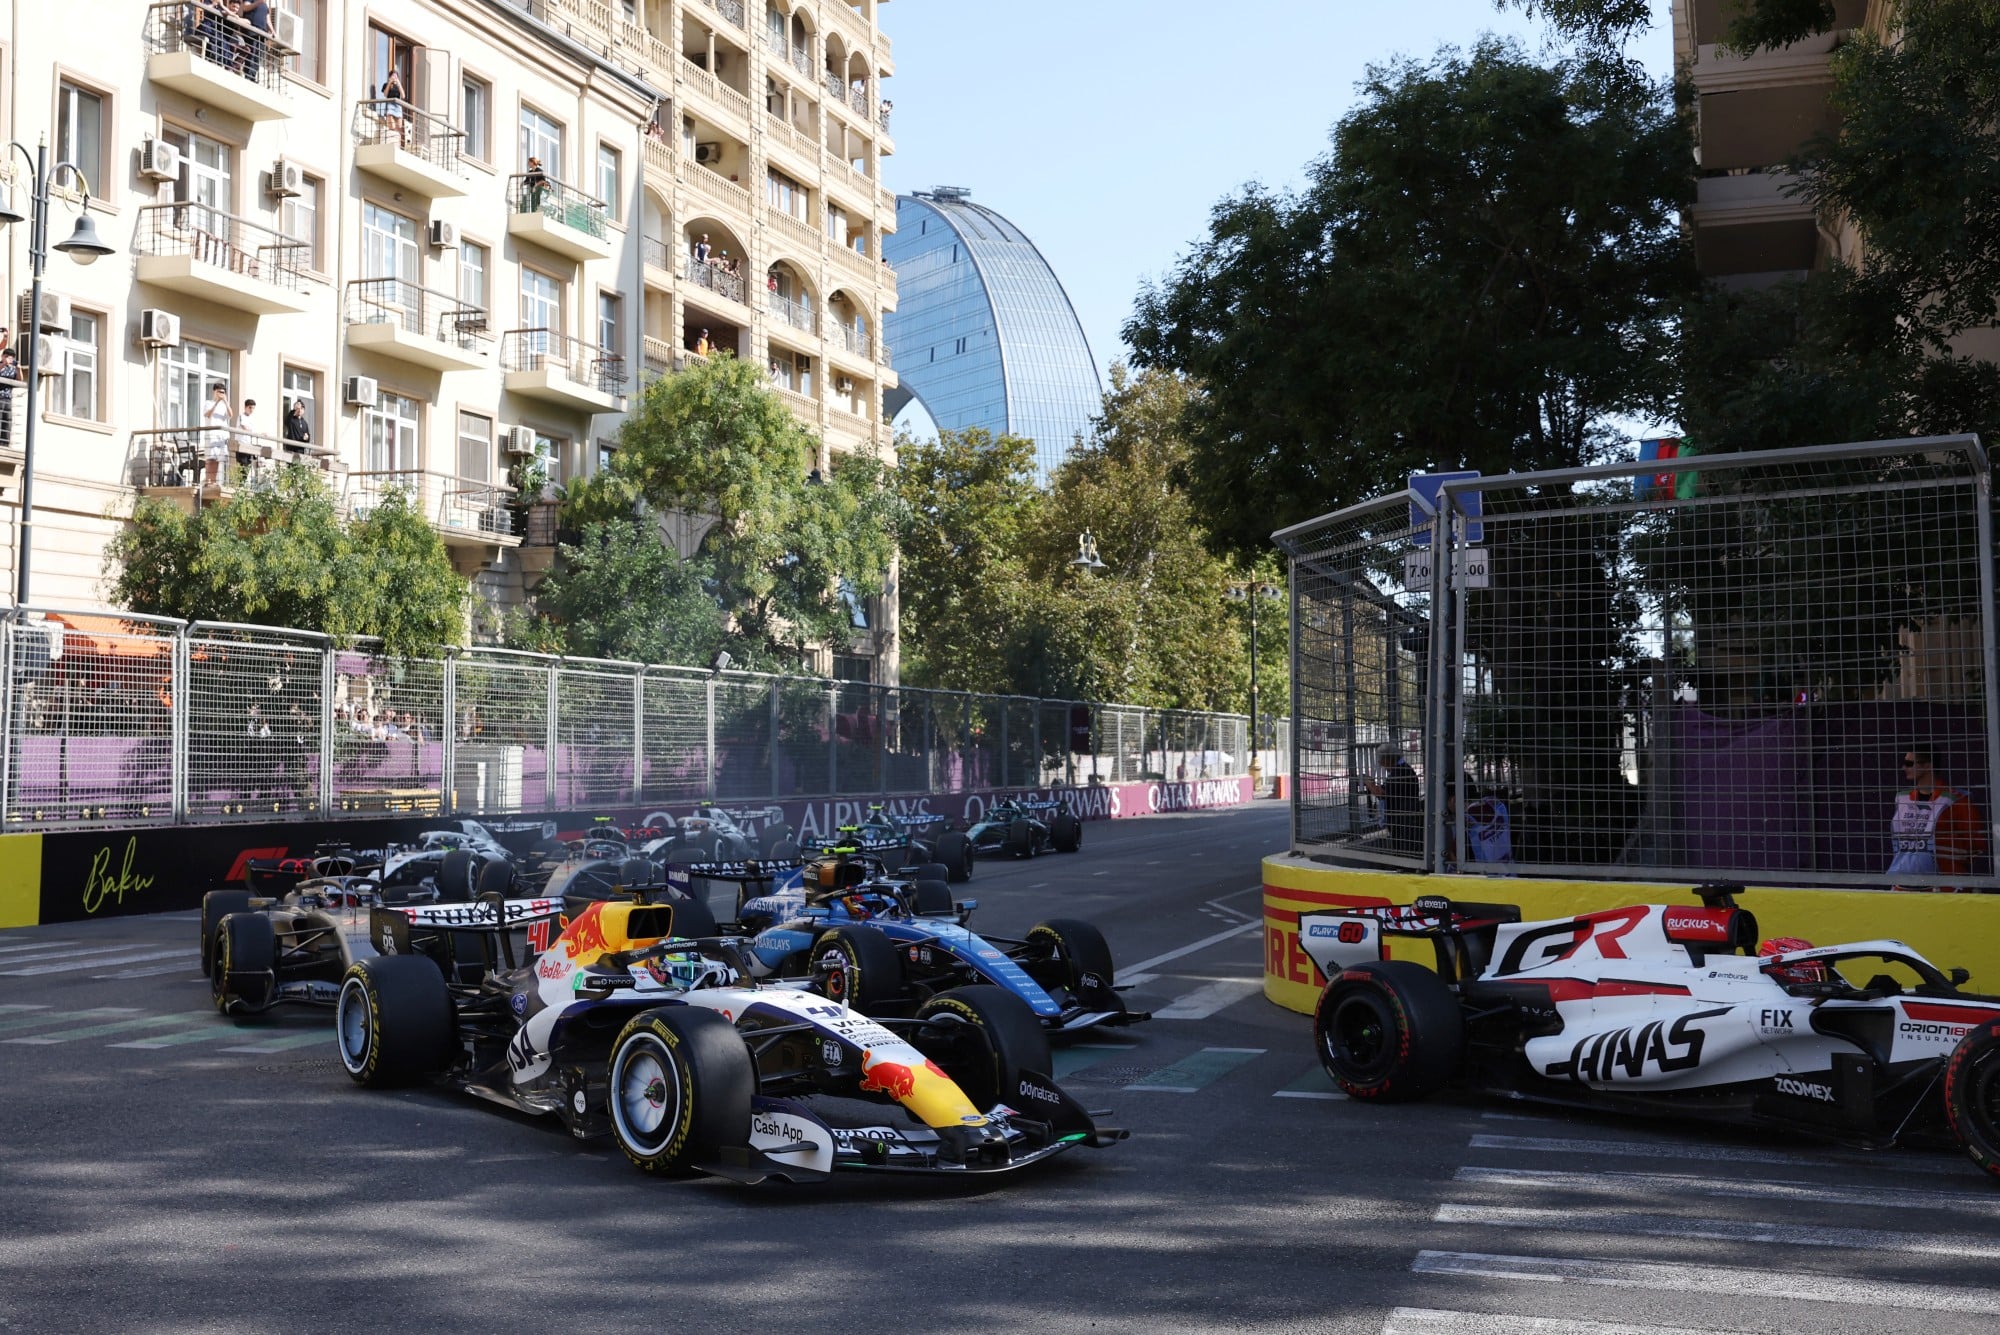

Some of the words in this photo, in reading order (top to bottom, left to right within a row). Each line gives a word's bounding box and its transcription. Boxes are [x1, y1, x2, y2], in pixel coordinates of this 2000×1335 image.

[1148, 783, 1193, 813] QATAR
[1195, 779, 1241, 806] AIRWAYS
[83, 835, 154, 913] Baku
[690, 860, 793, 875] ATLASIAN
[424, 904, 525, 925] TUDOR
[1667, 917, 1710, 929] RUCKUS
[528, 920, 551, 955] 41
[1339, 922, 1365, 944] GO
[1717, 971, 1749, 982] emburse
[832, 1019, 878, 1028] VISA
[1760, 1008, 1794, 1028] FIX
[1760, 1027, 1795, 1036] NETWORK
[1901, 1033, 1959, 1044] INSURAN
[507, 1023, 549, 1073] ISA
[823, 1045, 840, 1063] FIA
[1026, 1082, 1061, 1104] dynatrace
[1773, 1077, 1836, 1102] ZOOMEX
[753, 1117, 780, 1137] Cash
[782, 1122, 803, 1144] App
[833, 1129, 900, 1150] UDOR
